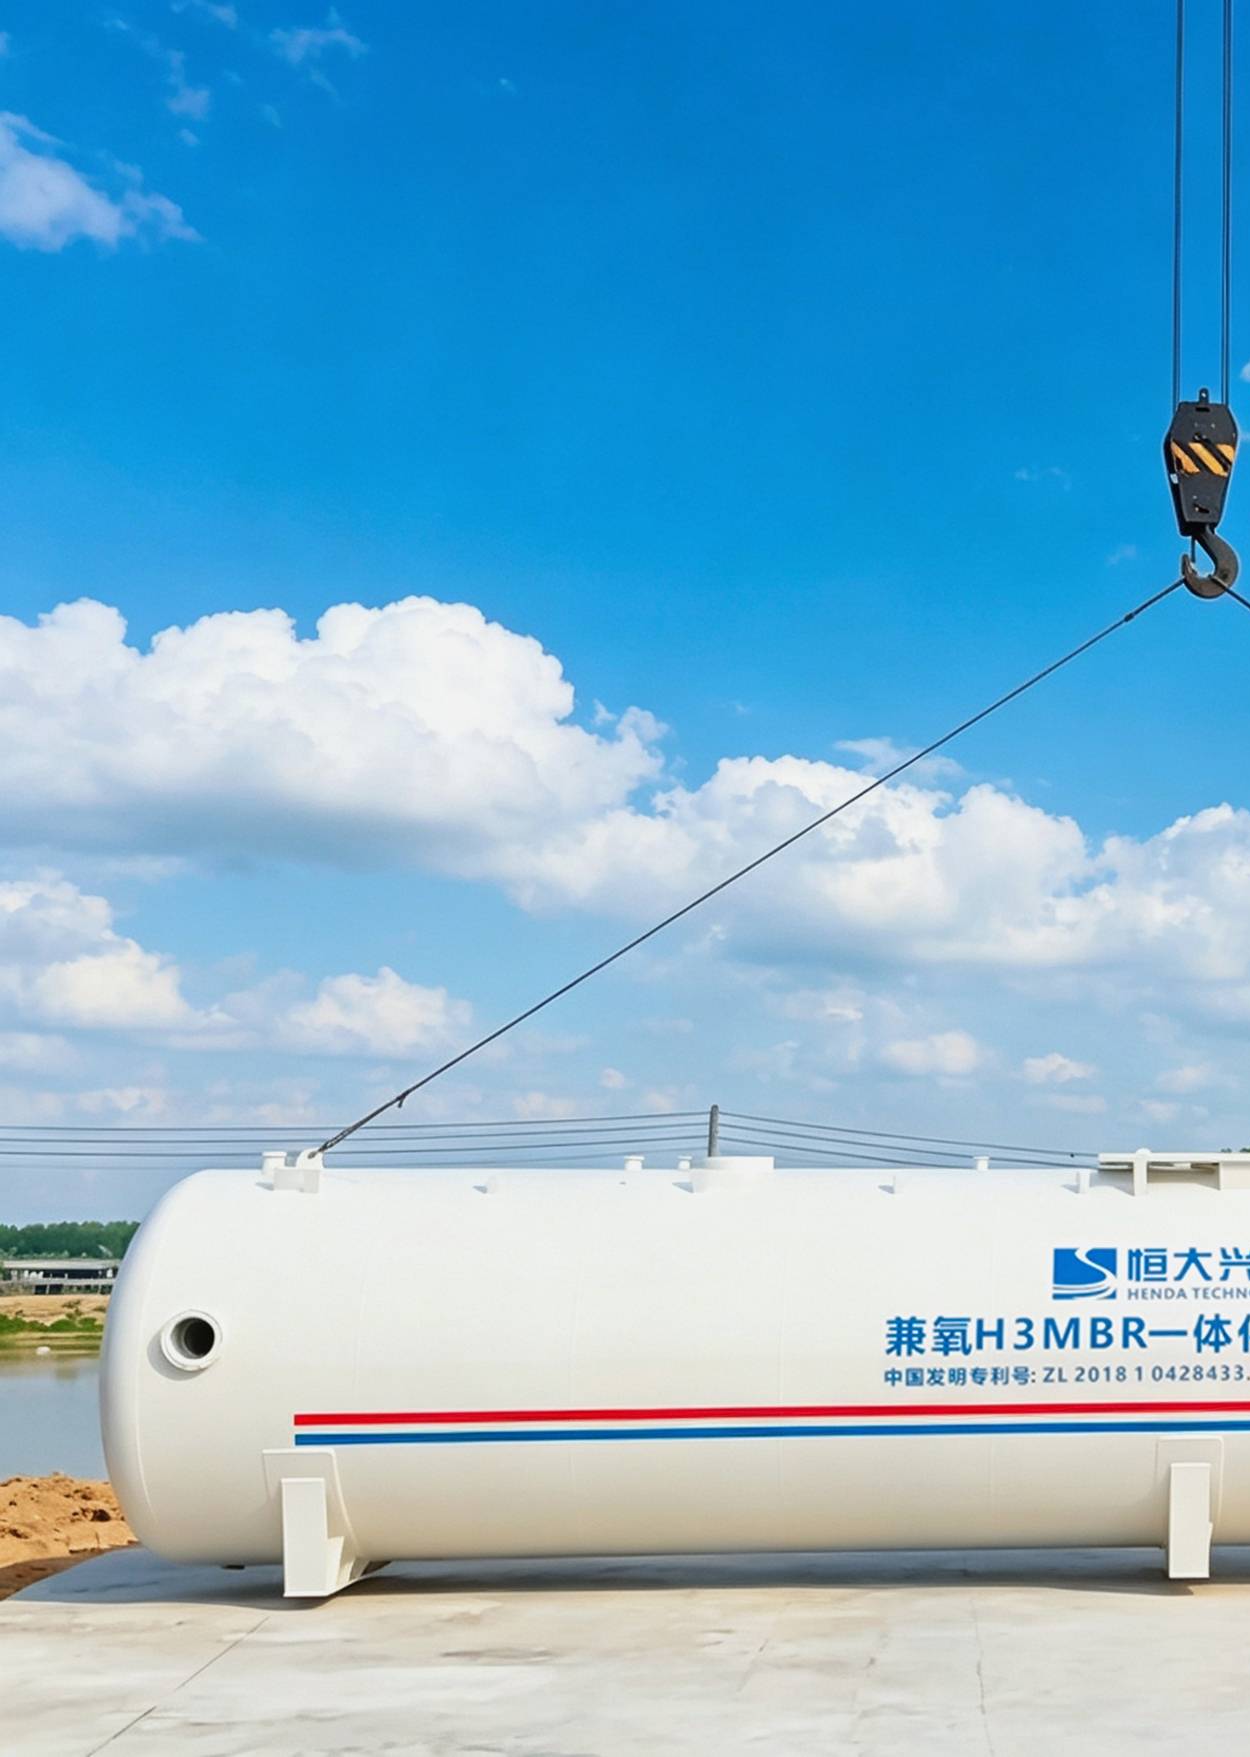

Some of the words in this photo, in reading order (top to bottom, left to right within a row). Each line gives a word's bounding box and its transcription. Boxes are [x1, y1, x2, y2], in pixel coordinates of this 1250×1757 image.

[1127, 1288, 1187, 1300] HENDA
[884, 1366, 1037, 1387] 中国发明专利号:
[1042, 1367, 1068, 1383] ZL
[1074, 1366, 1127, 1383] 2018
